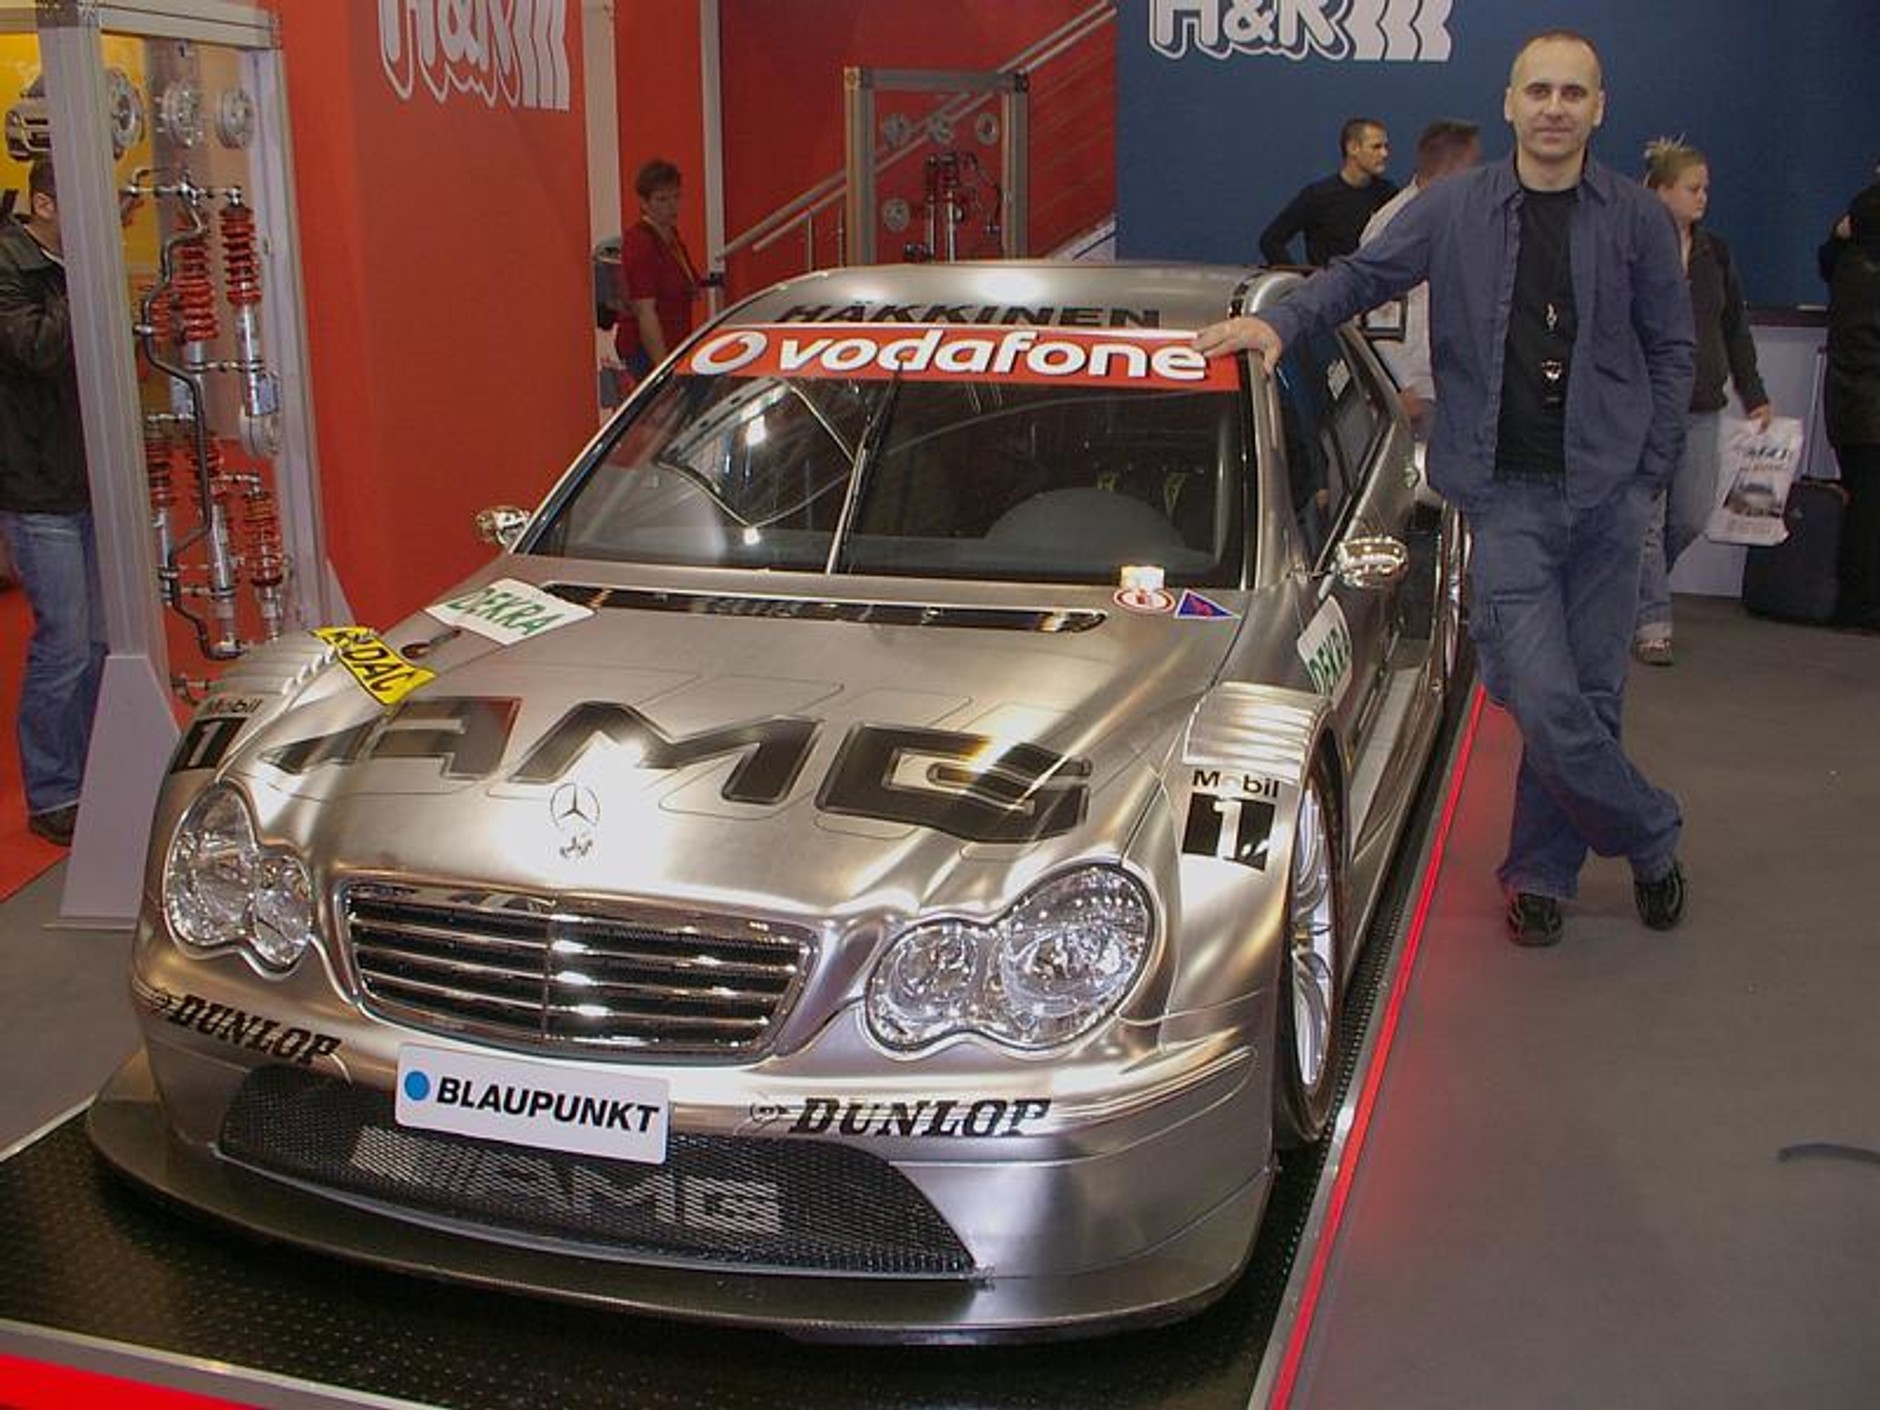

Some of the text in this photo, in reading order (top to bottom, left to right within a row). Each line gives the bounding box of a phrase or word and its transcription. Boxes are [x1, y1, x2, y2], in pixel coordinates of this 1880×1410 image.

[777, 329, 1208, 381] vodafone
[187, 720, 225, 768] 1
[258, 694, 1094, 845] AMG
[1191, 769, 1280, 799] Mbil
[1213, 800, 1243, 860] 1
[167, 993, 342, 1066] DUNLOP
[435, 1076, 662, 1135] BLAUPUNKT
[787, 1098, 1052, 1138] DUNLOP
